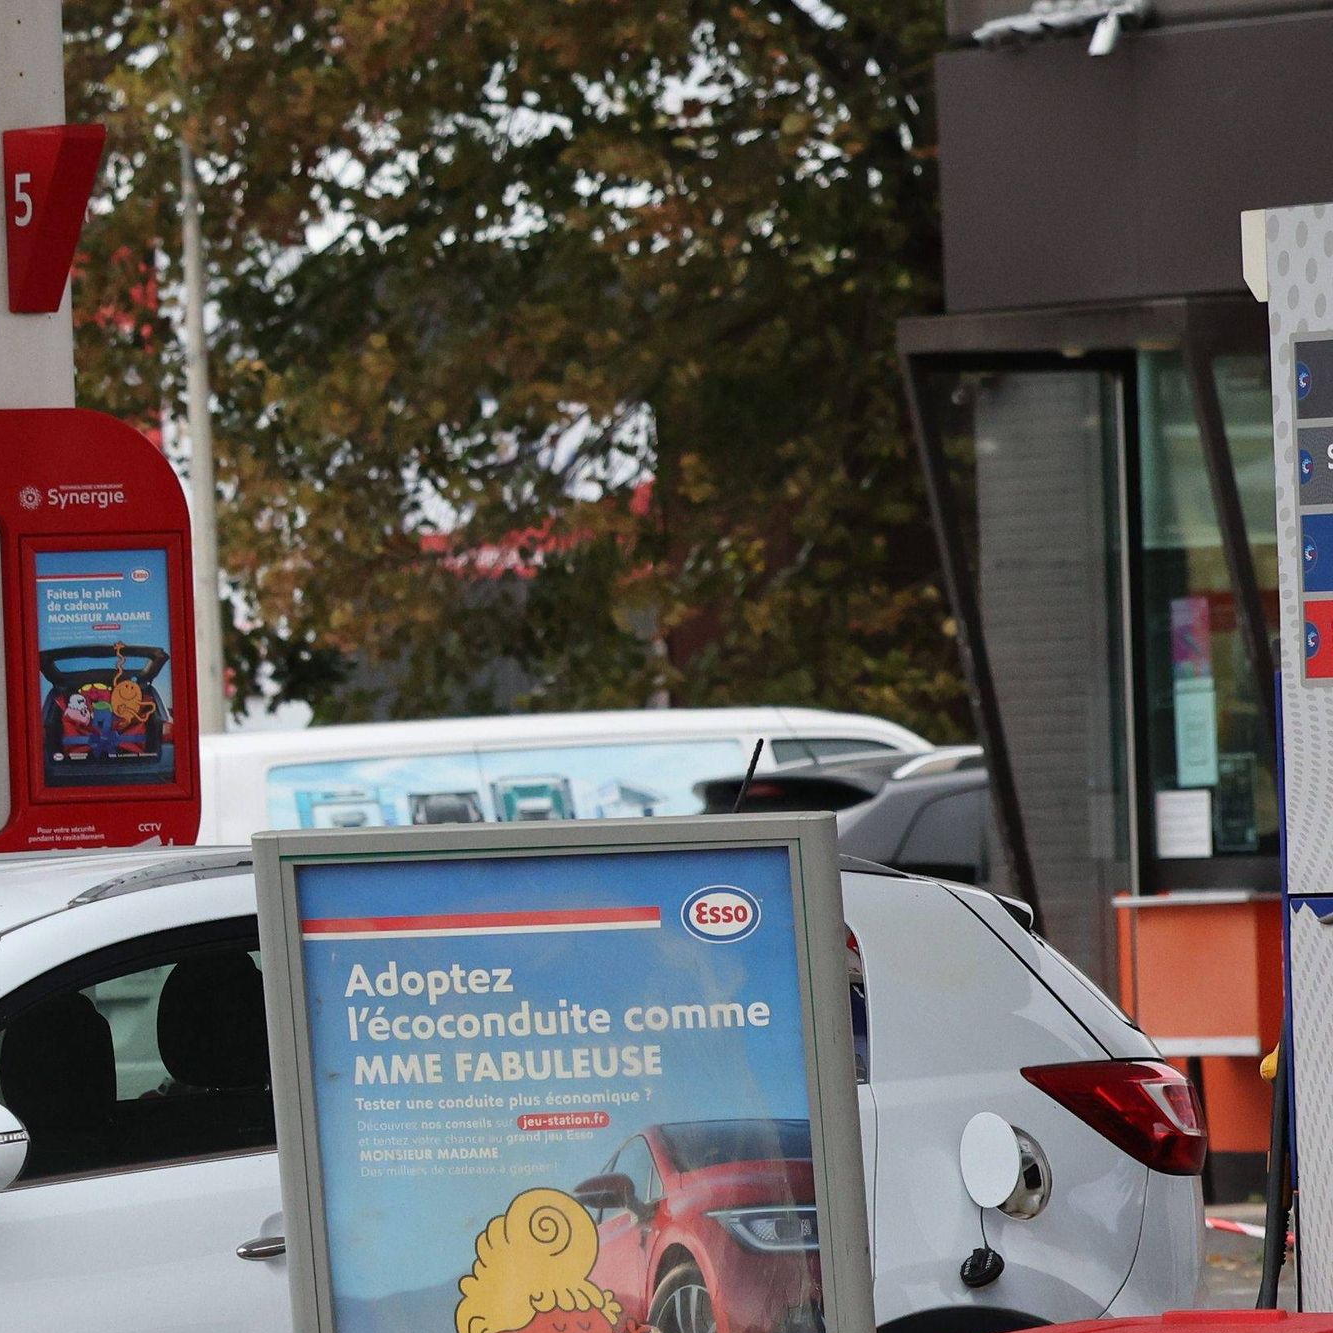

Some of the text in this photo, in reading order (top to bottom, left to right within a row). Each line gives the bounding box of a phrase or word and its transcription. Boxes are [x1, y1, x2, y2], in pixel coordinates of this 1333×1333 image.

[14, 173, 32, 226] 5
[48, 488, 125, 510] Synergie
[47, 587, 122, 600] Faites le plein
[47, 600, 109, 611] de cadeaux
[49, 611, 151, 623] MONSIEUR MADAME
[138, 823, 162, 832] CCTV
[695, 902, 748, 925] Esso
[344, 961, 514, 1005] Adoptez
[348, 999, 770, 1041] l'écoconduite comme
[354, 1044, 662, 1085] MME FABULEUSE
[354, 1088, 652, 1111] Tester une conduite plus économique ?
[357, 1113, 605, 1132] Découvrez nos conseils sur jeu-station.fr
[359, 1136, 370, 1146] et
[373, 1136, 408, 1146] tentez
[412, 1135, 440, 1145] votre
[445, 1133, 485, 1143] chance
[507, 1131, 540, 1145] grand
[544, 1130, 563, 1144] jeu
[567, 1131, 594, 1141] Esso
[360, 1147, 499, 1162] MONSIEUR MADAME
[361, 1166, 383, 1177] Des
[386, 1165, 426, 1176] milliers
[431, 1164, 445, 1174] de
[448, 1163, 496, 1174] cadeaux
[509, 1163, 552, 1177] gagner
